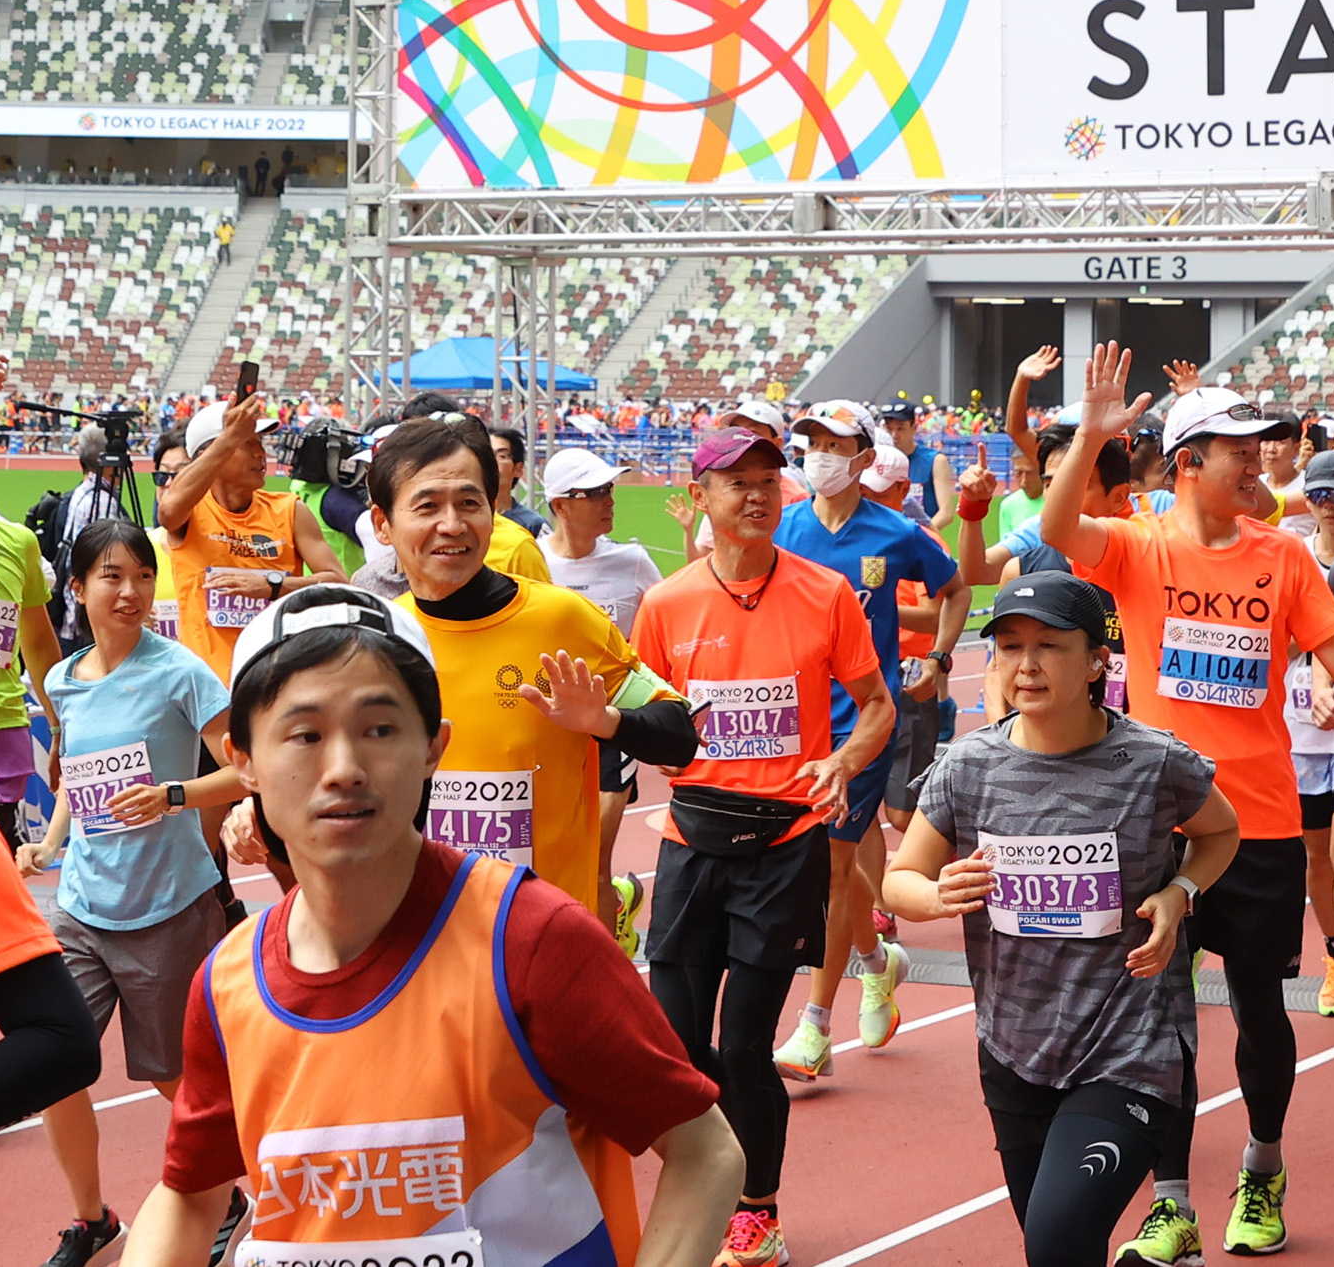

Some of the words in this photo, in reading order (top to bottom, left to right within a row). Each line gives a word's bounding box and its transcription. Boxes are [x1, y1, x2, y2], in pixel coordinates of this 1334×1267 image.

[102, 116, 156, 129] TOKYO
[160, 117, 219, 130] LEGACY
[223, 118, 260, 130] HALF
[267, 119, 305, 131] 2022
[1114, 120, 1234, 150] TOKYO
[1084, 255, 1163, 282] GATE
[1171, 255, 1188, 280] 3
[1163, 586, 1270, 623] TOKYO
[1186, 628, 1225, 642] TOKYO
[1226, 634, 1269, 653] 2022
[1186, 638, 1207, 647] LEGACY
[1167, 649, 1259, 684] A11044
[706, 687, 742, 698] TOKYO
[744, 684, 794, 703] 2022
[703, 709, 782, 735] 13047
[95, 751, 145, 775] 2022
[430, 781, 462, 792] KYO
[464, 781, 528, 802] 2022
[426, 811, 512, 843] 14175
[999, 845, 1045, 857] TOKYO
[1048, 842, 1114, 865] 2022
[1019, 916, 1050, 925] POCARI
[1052, 916, 1081, 925] SWEAT
